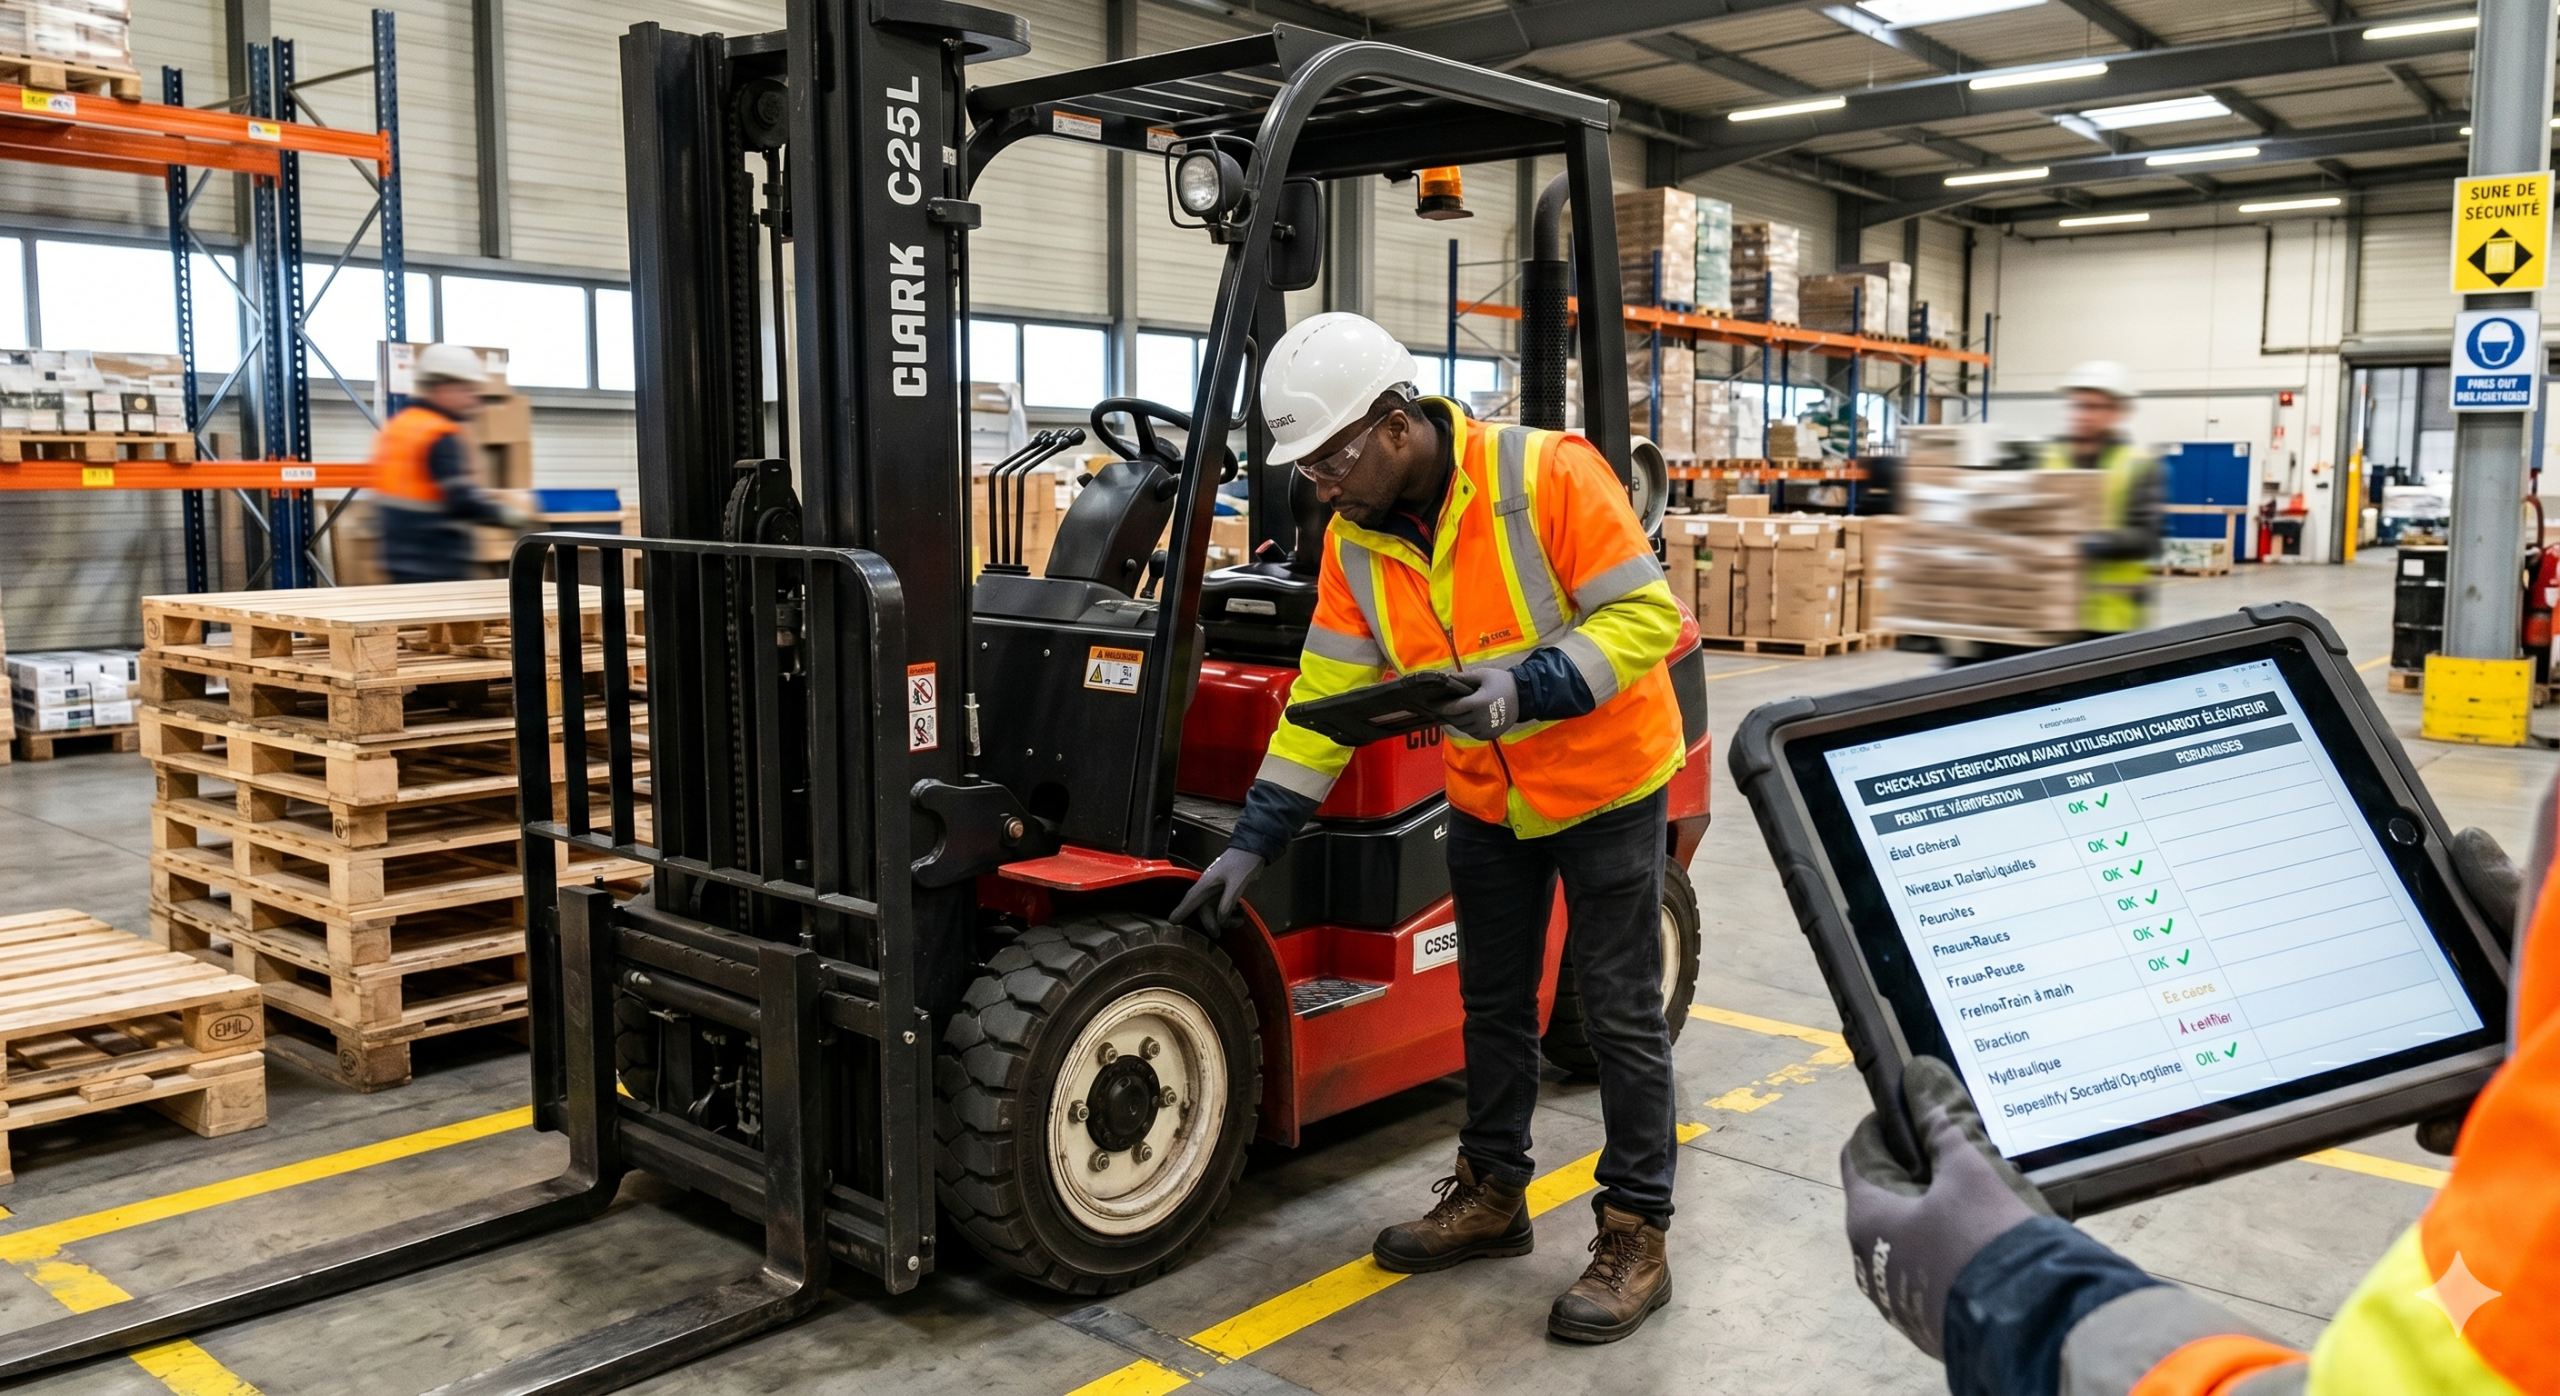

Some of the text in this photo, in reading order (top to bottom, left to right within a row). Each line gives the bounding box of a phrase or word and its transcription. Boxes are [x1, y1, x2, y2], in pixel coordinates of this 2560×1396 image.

[2517, 182, 2537, 197] DE
[886, 75, 928, 397] CLARK C25L
[1874, 769, 1945, 797] CHECK-LIST
[1948, 750, 2031, 783] VÉRIFICATION
[2032, 742, 2070, 764] AVANT
[2070, 727, 2144, 755] UTILISATION
[2149, 714, 2203, 738] CHARIOT
[2201, 699, 2270, 726] ÉLÉVATEUR
[2068, 800, 2089, 816] OK
[2087, 838, 2109, 854] OK
[2102, 866, 2124, 883] OK
[1904, 877, 1954, 898] Niveaux
[2117, 895, 2139, 912] OK
[2132, 925, 2155, 943] OK
[2147, 955, 2170, 972] OK
